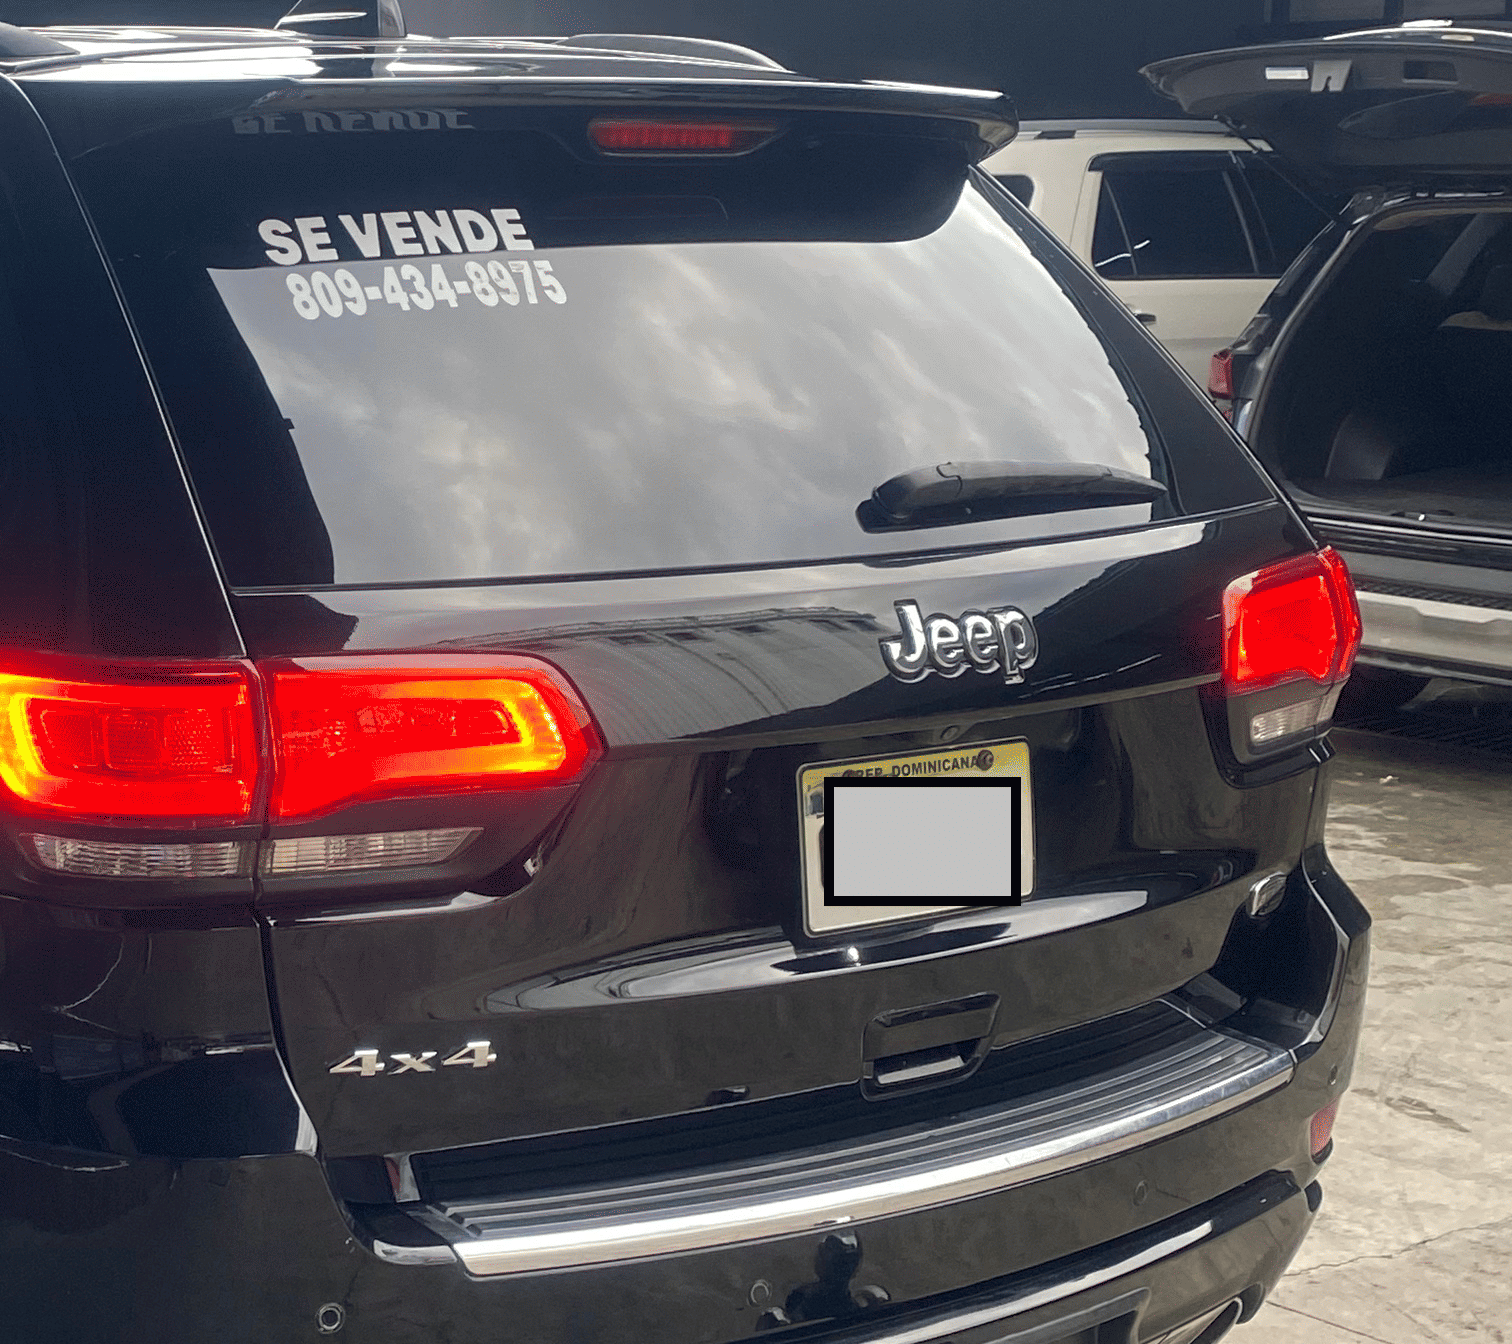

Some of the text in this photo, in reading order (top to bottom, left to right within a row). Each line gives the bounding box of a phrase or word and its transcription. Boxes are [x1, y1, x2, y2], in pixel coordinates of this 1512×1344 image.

[257, 208, 535, 266] SE VENDE
[286, 259, 567, 320] 809-434-8975
[878, 598, 1039, 684] Jeep
[328, 1040, 497, 1077] 4x4
